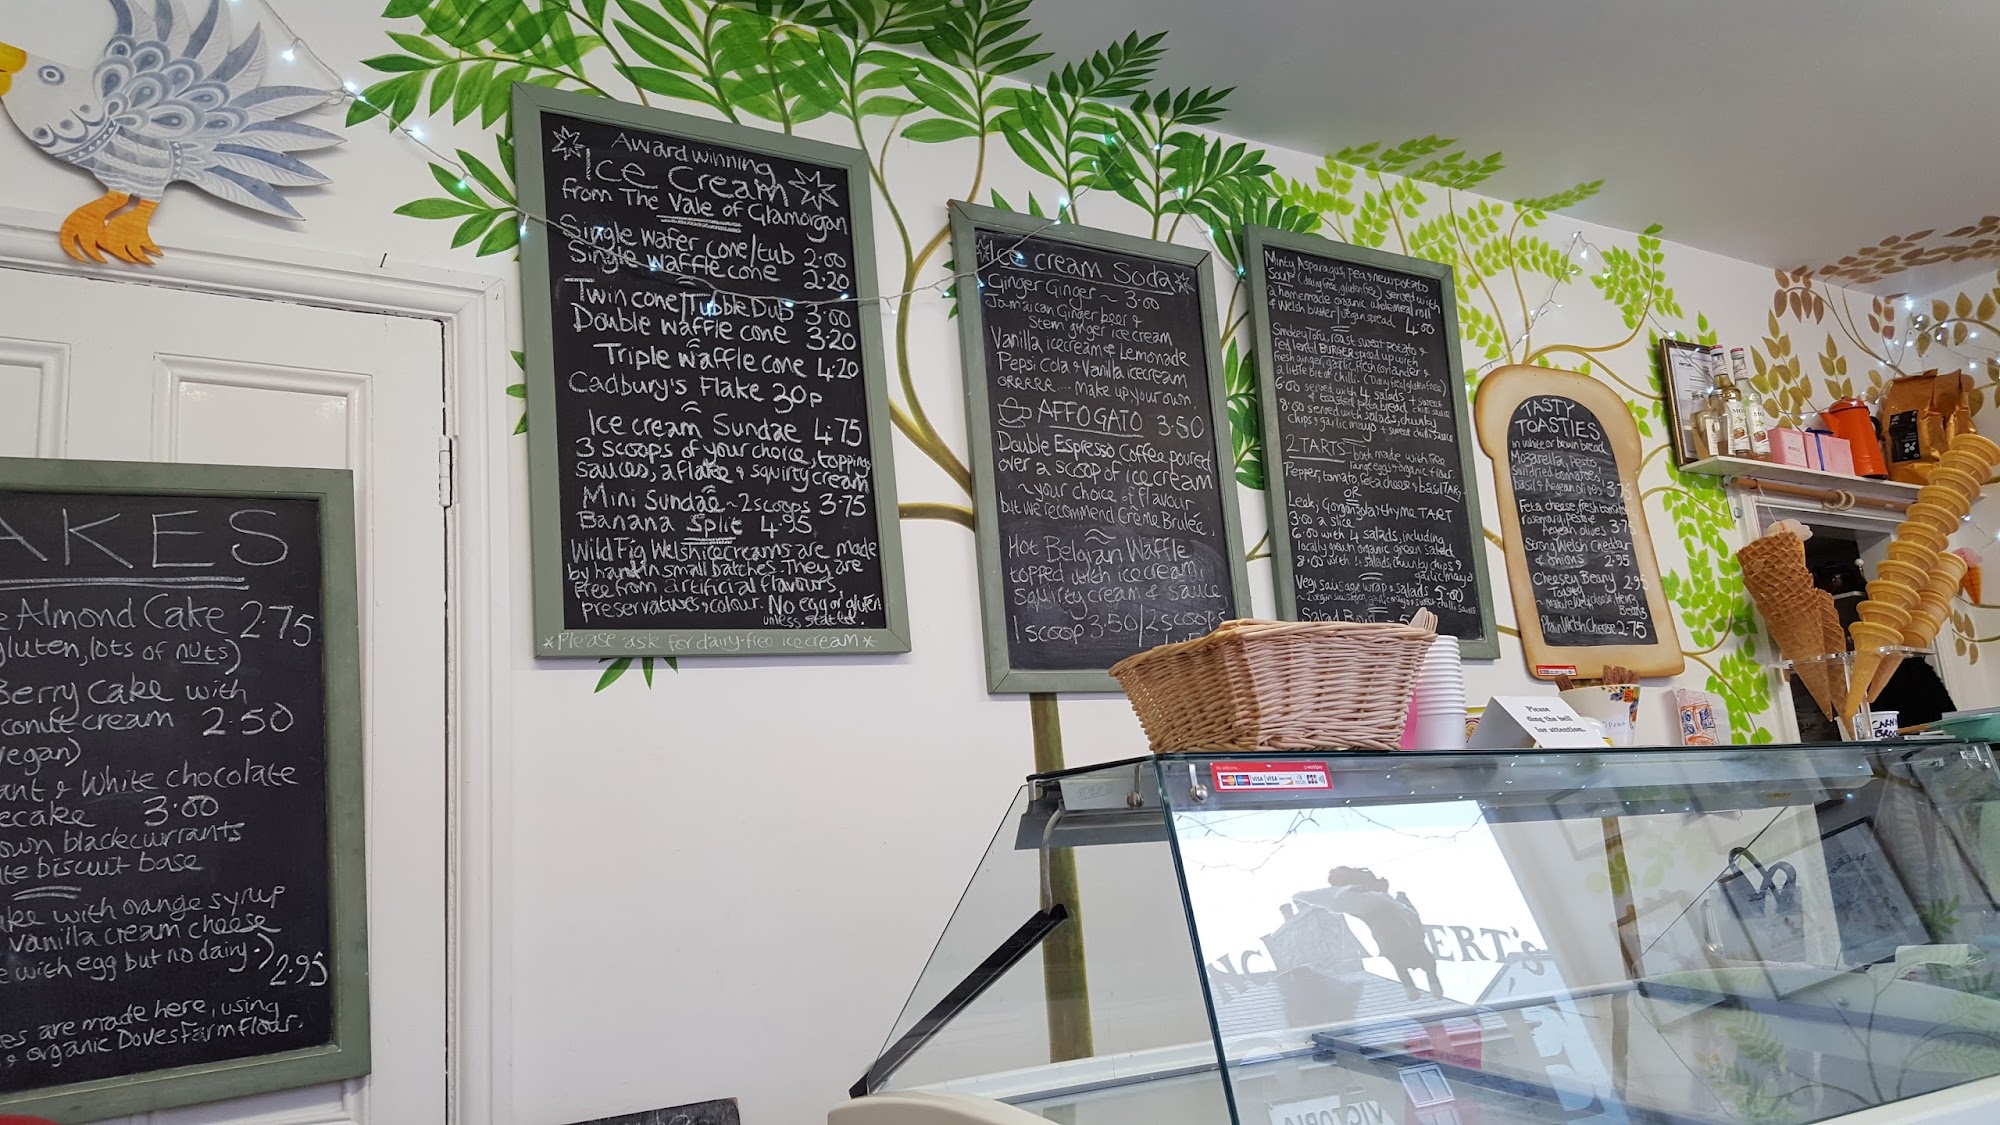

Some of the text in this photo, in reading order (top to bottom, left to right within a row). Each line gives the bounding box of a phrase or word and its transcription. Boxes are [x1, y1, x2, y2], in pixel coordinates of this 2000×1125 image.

[611, 132, 775, 185] Award winning
[584, 147, 790, 208] Ice Cream
[618, 187, 659, 212] The
[669, 192, 713, 218] Vale
[723, 197, 744, 219] of
[748, 206, 848, 244] Glamorgan
[559, 212, 638, 248] Single
[642, 226, 700, 252] wafer
[567, 239, 637, 274] Single
[728, 263, 780, 283] cone
[1034, 252, 1103, 279] cream
[1113, 261, 1176, 294] Soda
[987, 273, 1044, 300] Ginger
[1045, 279, 1096, 310] Ginger
[570, 302, 651, 335] Double
[661, 317, 732, 338] waffle
[740, 325, 792, 344] cone
[990, 325, 1043, 353] Vanilla
[593, 342, 671, 372] Triple
[679, 345, 756, 372] waffle
[761, 356, 808, 378] cone
[569, 371, 688, 402] Cadbury's
[700, 377, 765, 402] Flake
[1037, 399, 1205, 440] AFFOGATO 3.50
[1520, 398, 1575, 418] TASTY
[589, 409, 627, 436] Ice
[631, 416, 703, 440] cream
[712, 413, 802, 444] Sundae
[1515, 417, 1600, 440] TOASTIES
[575, 437, 595, 459] 3
[601, 442, 674, 464] scoops
[681, 439, 698, 459] of
[702, 441, 750, 467] your
[997, 430, 1052, 457] Double
[1054, 433, 1115, 461] Espresso
[1300, 437, 1346, 456] TARTS
[582, 482, 636, 509] Mini
[577, 510, 676, 534] Banana
[686, 512, 744, 537] Split
[1418, 507, 1452, 523] TART
[1008, 535, 1191, 566] Hot Belgian Waffle
[18, 593, 315, 647] Almond Cake 2.75
[1025, 624, 1085, 645] scoop
[90, 637, 134, 660] lots
[142, 641, 168, 661] of
[88, 672, 247, 703] Cake with
[82, 702, 295, 736] cream 2.50
[1525, 705, 1551, 713] Please
[81, 758, 299, 798] White chocolate
[143, 795, 219, 827] 3.00
[64, 822, 245, 853] blackcurrants
[38, 852, 204, 878] biscuit base
[53, 886, 286, 924] with orange syrup
[104, 922, 180, 945] cream
[189, 913, 282, 935] cheese
[76, 957, 116, 982] egg
[125, 948, 162, 971] but
[167, 948, 194, 963] no
[39, 1025, 76, 1041] are
[82, 1003, 148, 1032] made
[221, 997, 280, 1018] using
[27, 1040, 111, 1068] organic
